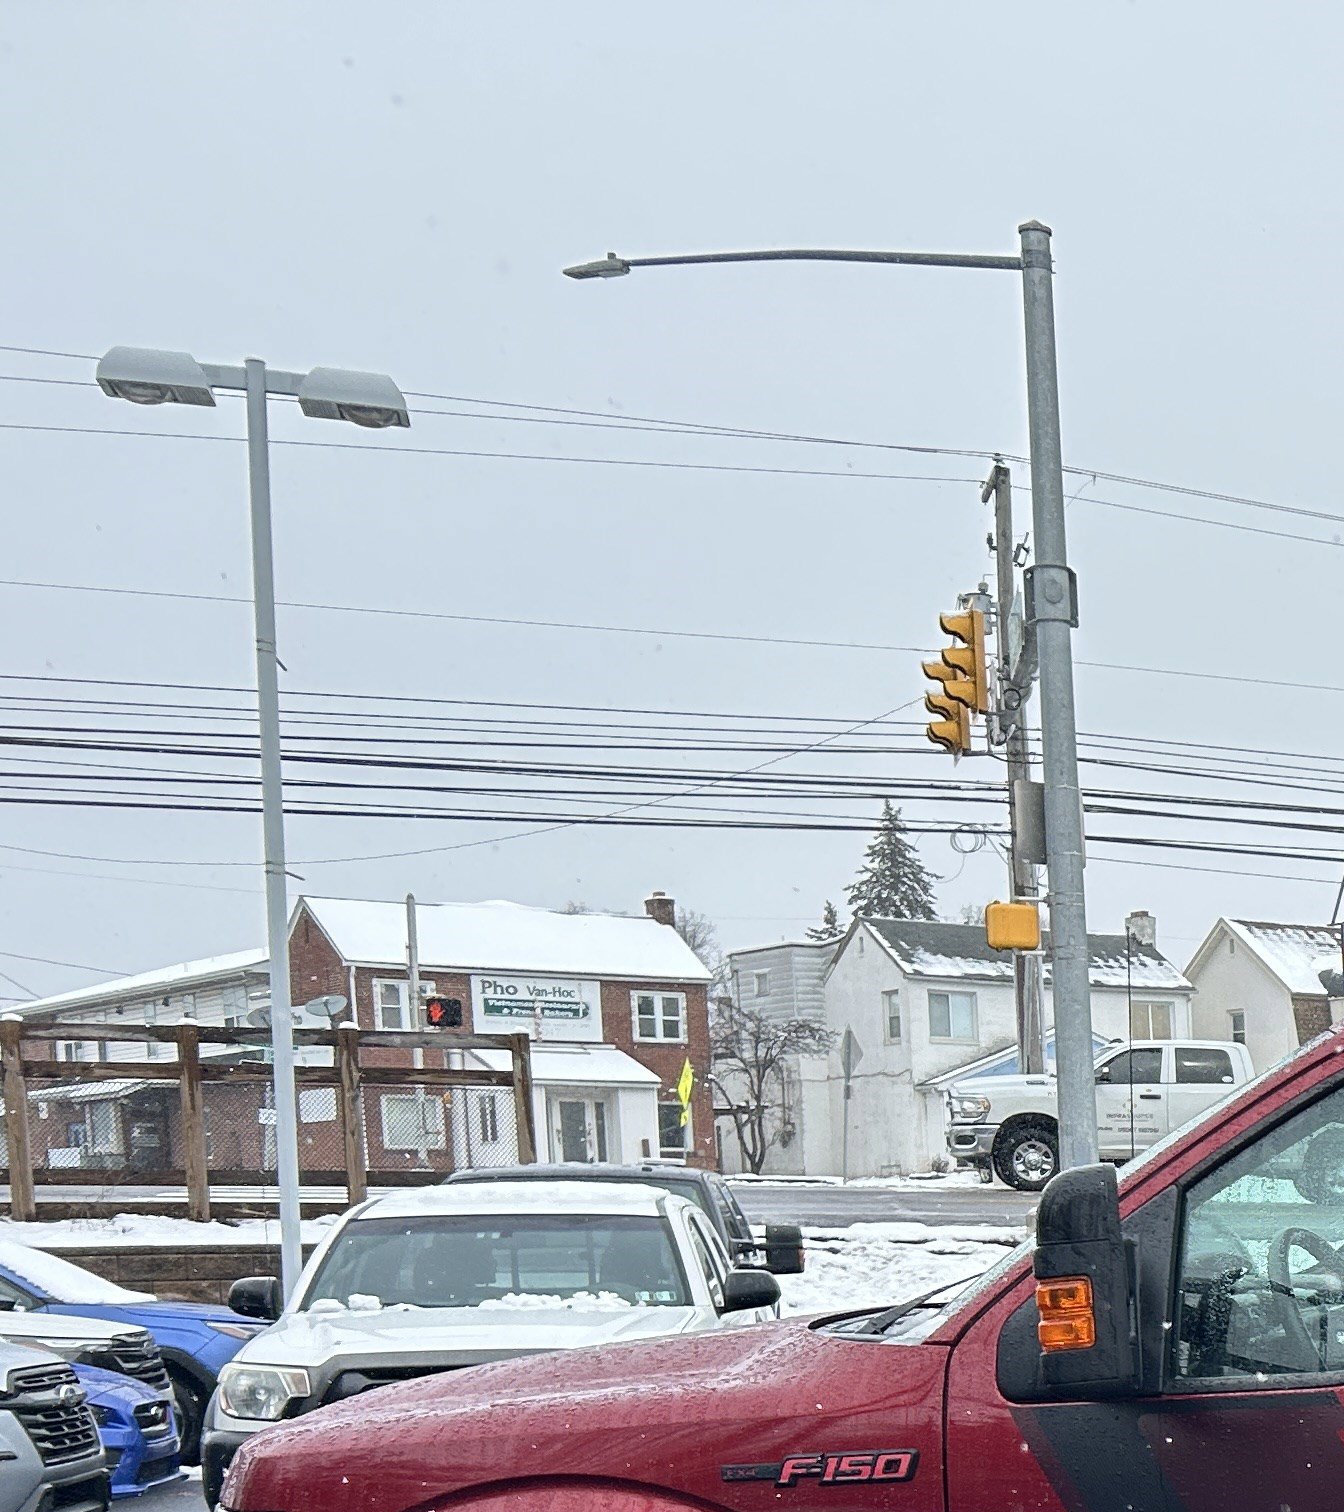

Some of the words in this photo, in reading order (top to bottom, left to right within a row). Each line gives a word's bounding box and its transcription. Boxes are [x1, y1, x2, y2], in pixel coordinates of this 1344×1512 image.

[480, 979, 518, 995] Pho
[526, 985, 576, 998] Van-Hoc
[777, 1451, 914, 1485] F-150
